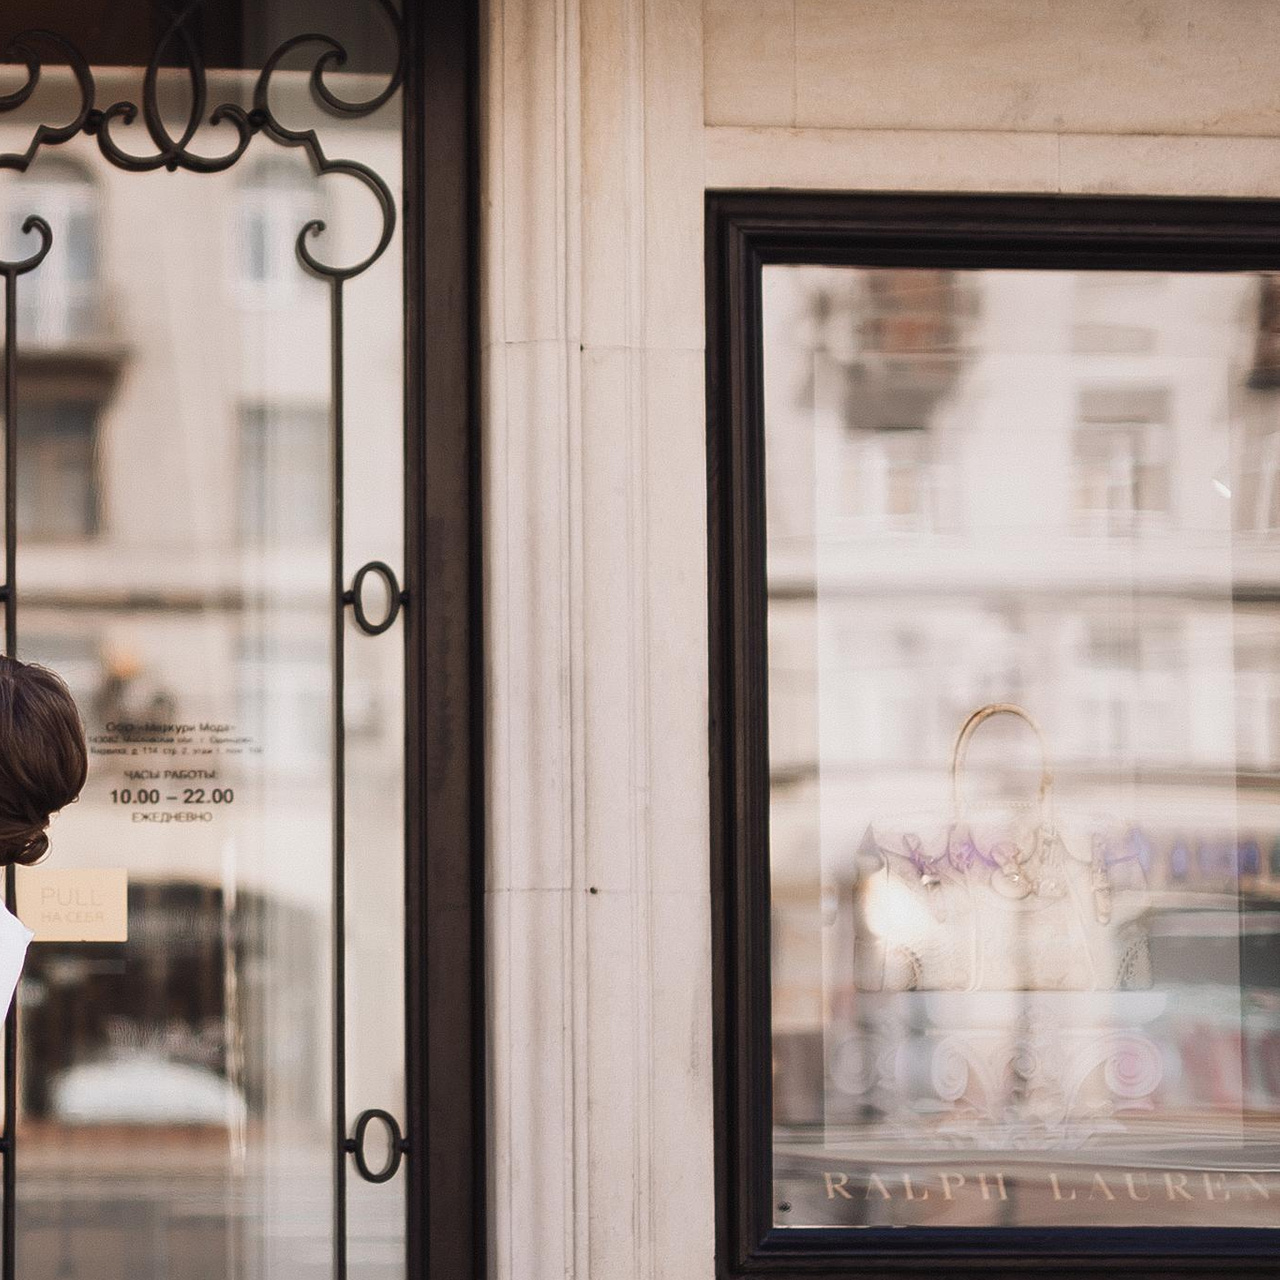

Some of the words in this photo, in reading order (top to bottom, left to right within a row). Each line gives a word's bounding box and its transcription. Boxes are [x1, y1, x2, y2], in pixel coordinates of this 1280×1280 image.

[123, 769, 159, 780] ЧАСЫ
[111, 788, 160, 804] 10.00
[183, 788, 234, 804] 22.00
[131, 811, 213, 823] ЕЖЕДНЕВНО
[41, 888, 103, 906] PULL
[824, 1171, 1008, 1200] RALPH
[1048, 1172, 1271, 1202] LAUREN
